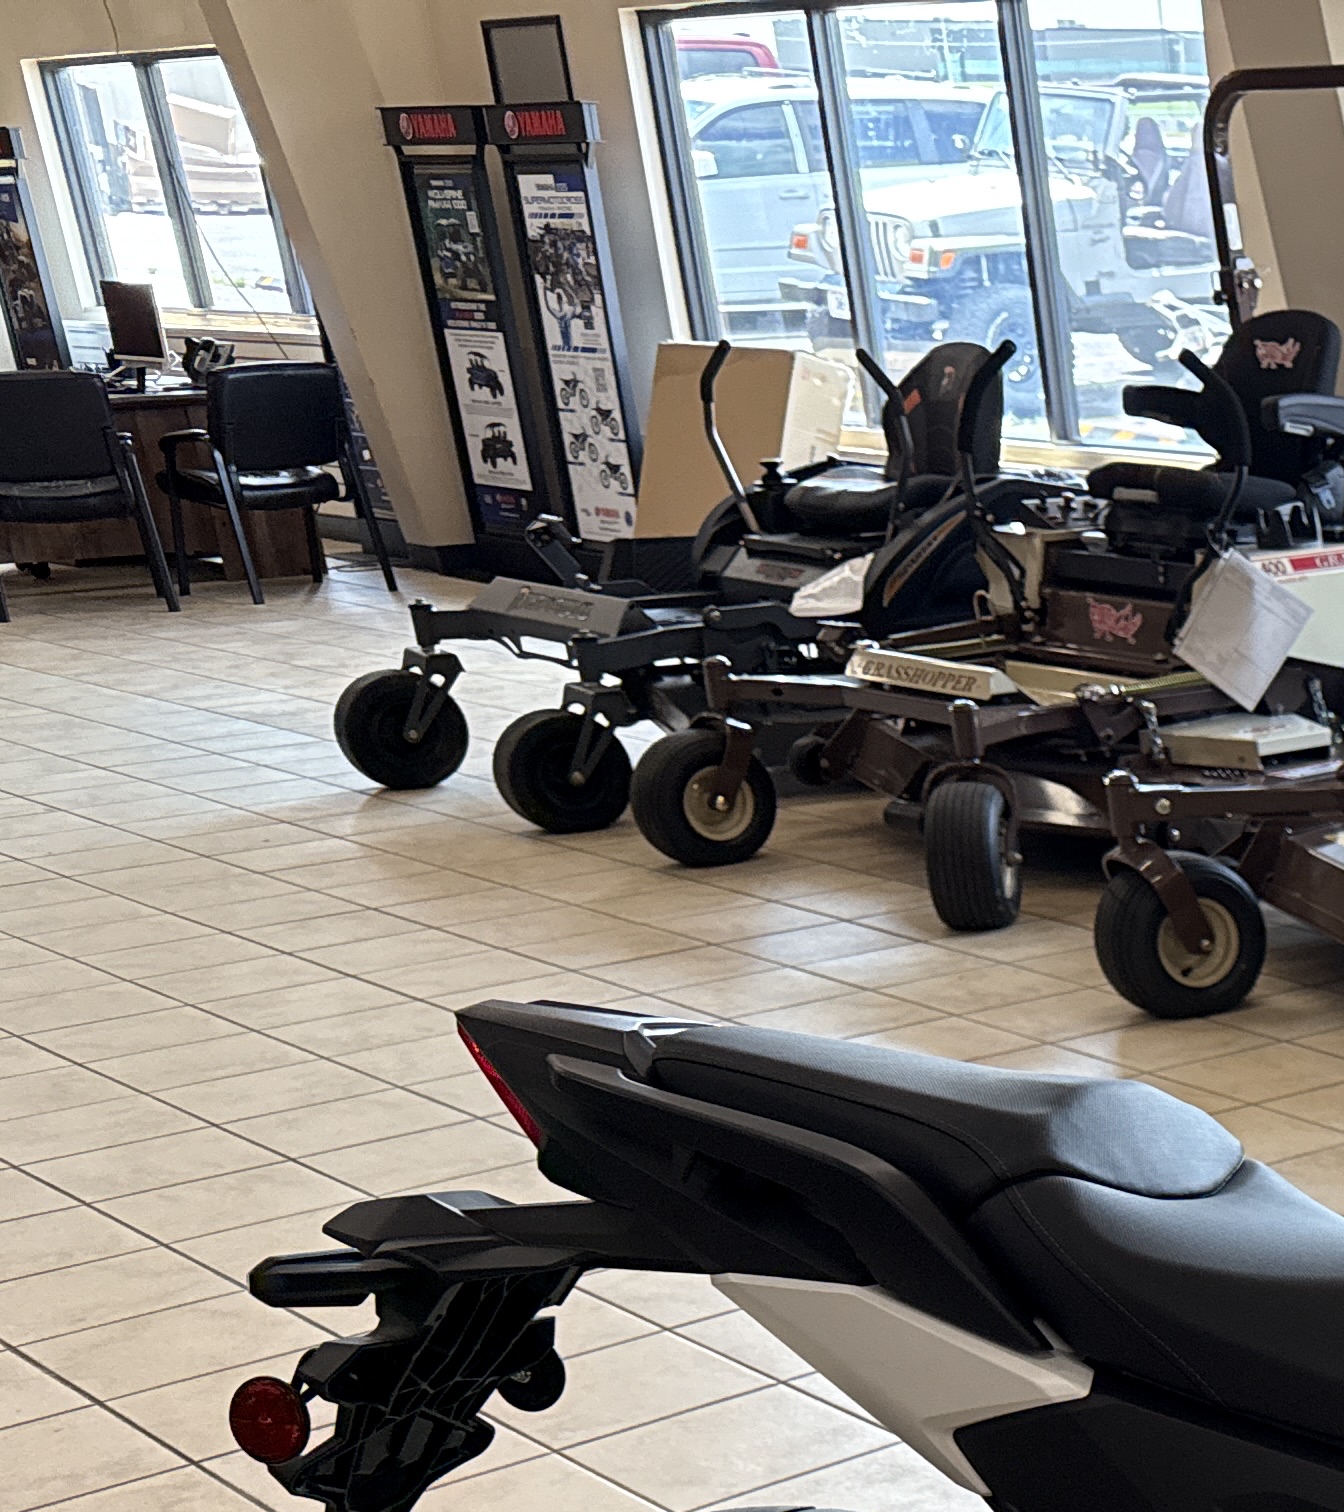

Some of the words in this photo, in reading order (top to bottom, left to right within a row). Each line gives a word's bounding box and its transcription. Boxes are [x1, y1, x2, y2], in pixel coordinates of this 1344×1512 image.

[410, 113, 457, 138] YAMAHA
[516, 110, 566, 136] YAMAHA
[862, 660, 977, 693] GRASSHOPPER
